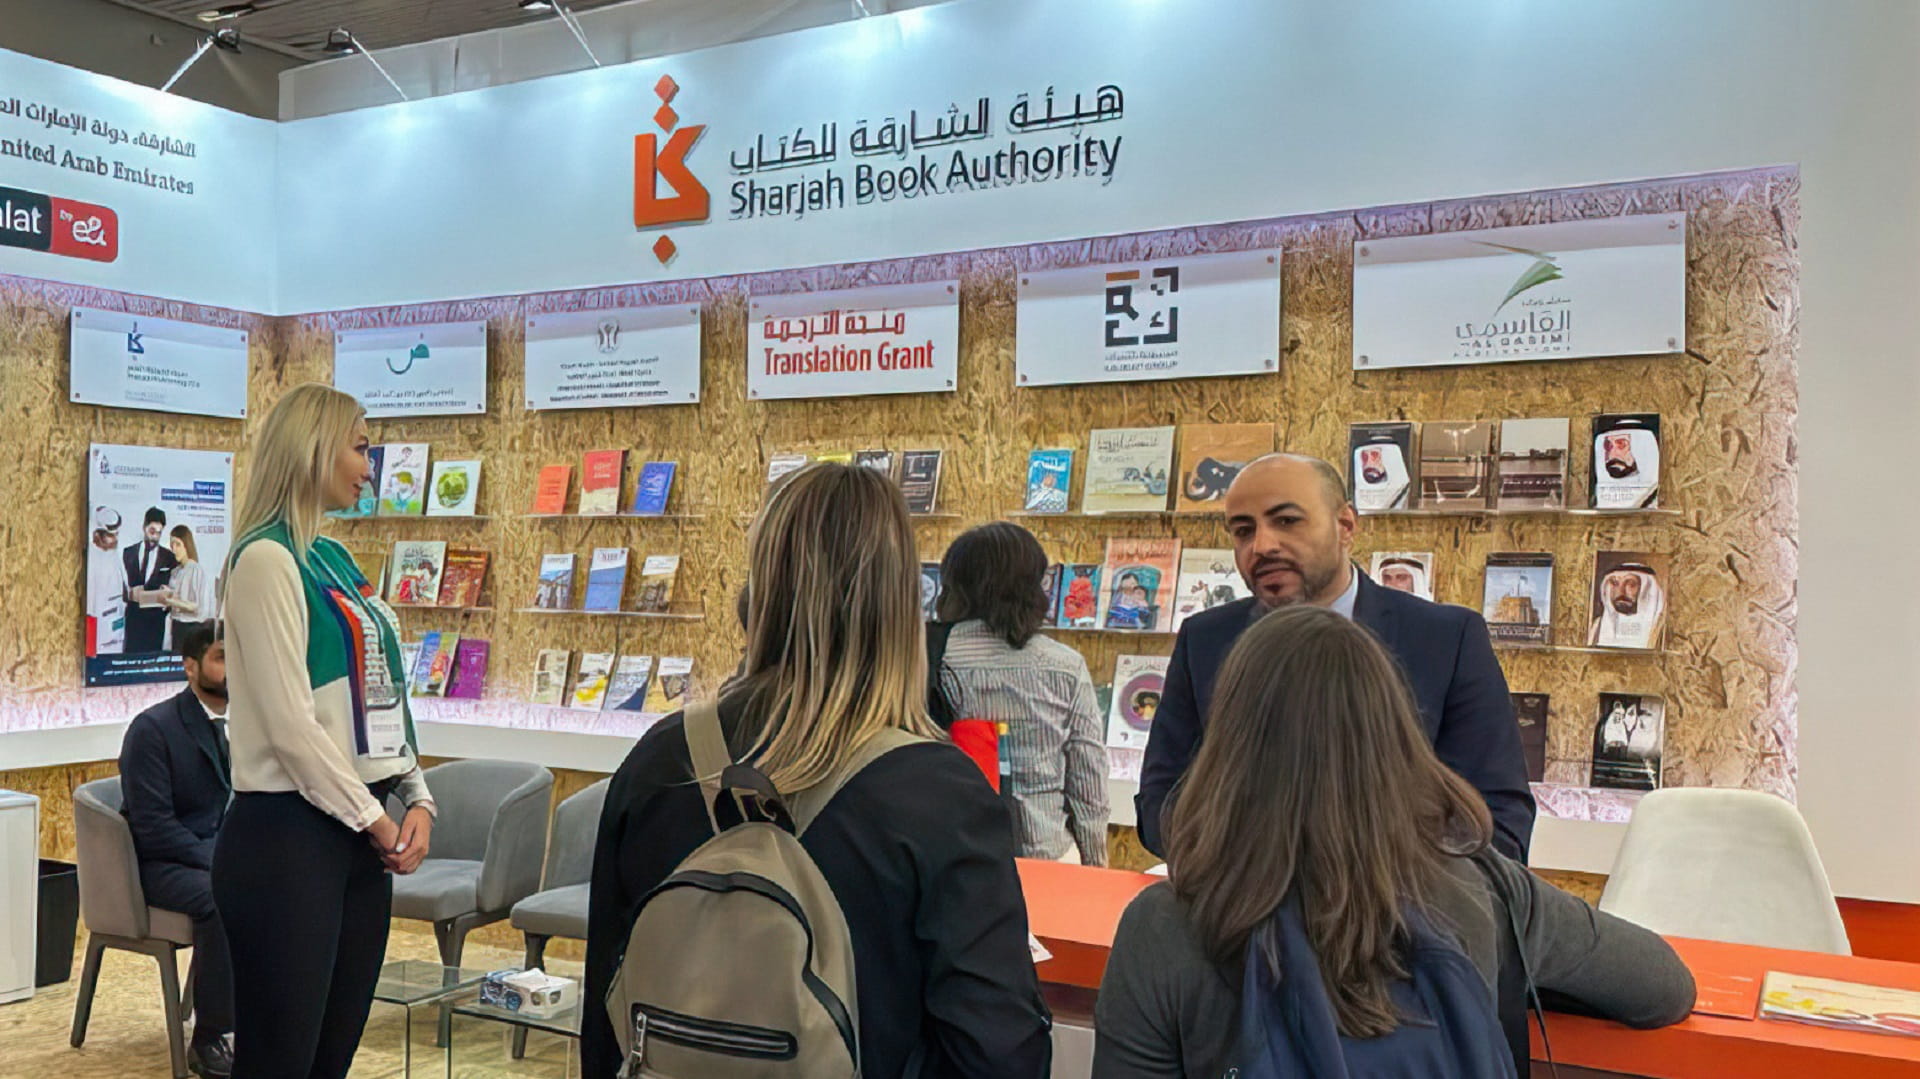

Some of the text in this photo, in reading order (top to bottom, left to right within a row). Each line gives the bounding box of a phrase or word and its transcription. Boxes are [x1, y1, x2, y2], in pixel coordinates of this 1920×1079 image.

[91, 119, 129, 144] دولة
[730, 83, 1124, 172] هيئة الشارقة للكتاب
[0, 138, 194, 195] nited Arab Emirates
[730, 133, 1123, 219] Sharjah Book Authority
[763, 307, 906, 344] منحة الترجمة
[763, 339, 935, 376] Translation Grant
